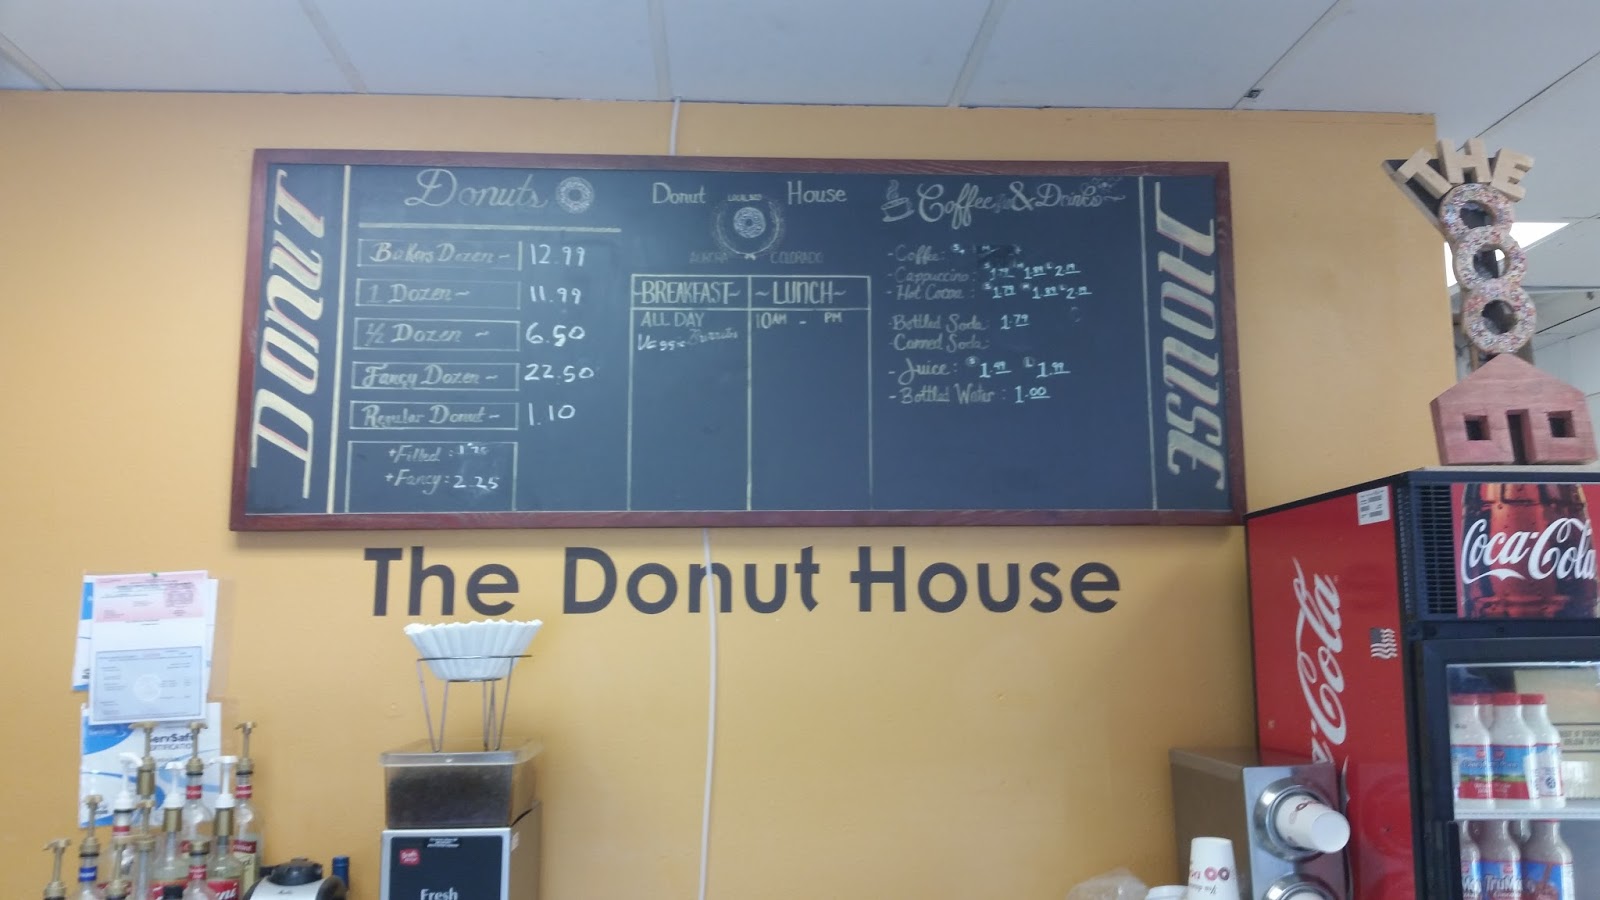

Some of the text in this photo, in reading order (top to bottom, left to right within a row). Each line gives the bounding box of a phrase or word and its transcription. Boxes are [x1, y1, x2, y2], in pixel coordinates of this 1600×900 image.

[1399, 138, 1535, 201] THE
[404, 169, 549, 207] Donuts
[652, 180, 847, 205] Donut House
[917, 180, 1104, 230] Coffee & Drinks
[436, 243, 494, 263] Dozen
[530, 243, 585, 266] 12.99
[387, 283, 452, 303] Dozen
[530, 285, 582, 305] 11.99
[641, 280, 734, 304] BREAKFAST
[772, 281, 834, 304] LUNCH
[640, 312, 705, 328] ALL DAY
[250, 169, 324, 499] DONUT
[391, 323, 463, 343] Dozen
[526, 322, 586, 347] 6.50
[1155, 181, 1225, 490] HOUSE
[361, 363, 480, 390] Fancy Dozen
[524, 363, 595, 382] 22.50
[1014, 385, 1050, 403] 1.00
[428, 404, 486, 424] Donut
[528, 402, 576, 426] 1.10
[1461, 517, 1597, 584] Coca-Cola
[364, 545, 1121, 616] The Donut House
[1293, 557, 1346, 763] a-Cola
[420, 887, 459, 900] Fresh
